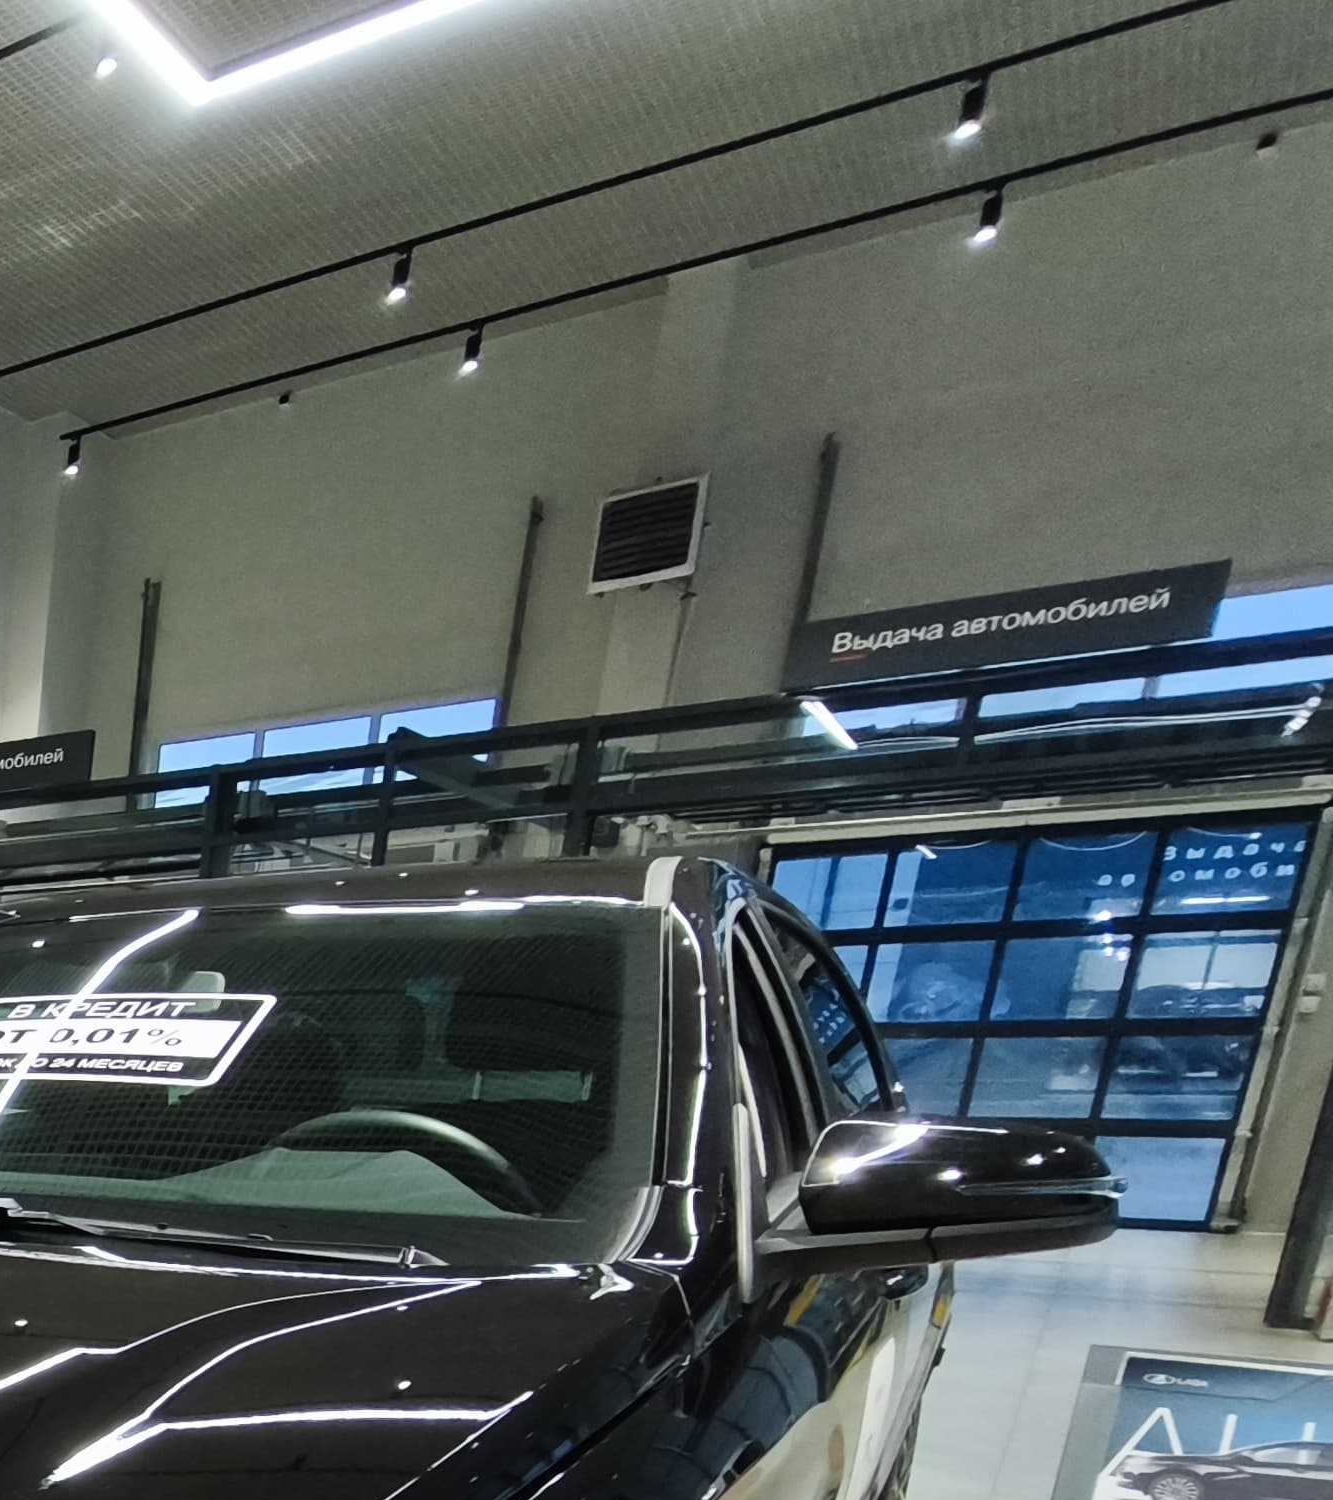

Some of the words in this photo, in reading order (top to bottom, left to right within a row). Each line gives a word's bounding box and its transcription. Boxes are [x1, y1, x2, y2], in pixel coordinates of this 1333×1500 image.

[832, 622, 943, 654] Выдача
[951, 586, 1171, 639] автомобилей
[7, 1003, 36, 1019] В
[40, 1001, 196, 1020] КРЕДИТ
[49, 1057, 76, 1070] 24
[76, 1057, 185, 1073] МЕСЯЦЕВ
